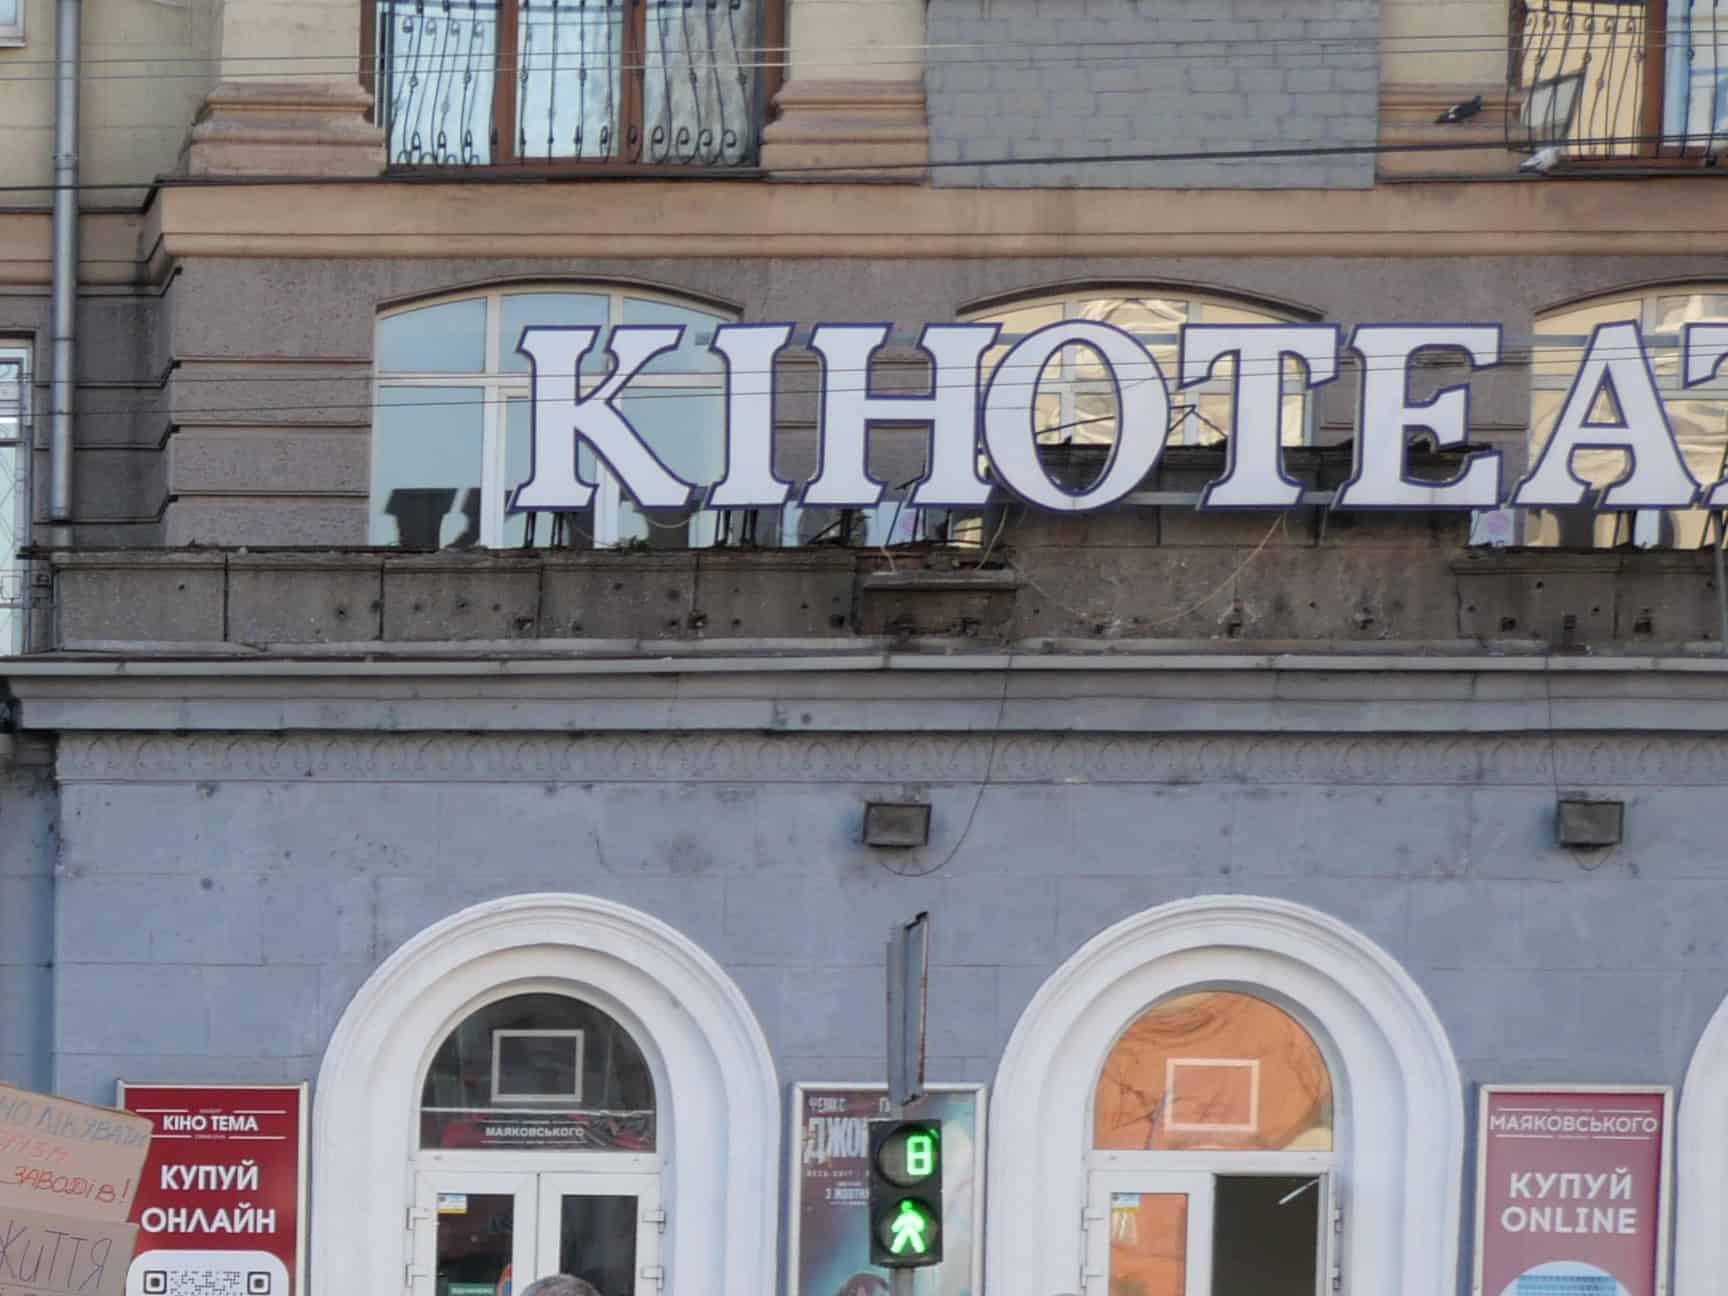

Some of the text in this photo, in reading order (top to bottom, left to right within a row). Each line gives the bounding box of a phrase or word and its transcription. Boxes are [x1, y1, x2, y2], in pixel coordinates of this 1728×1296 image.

[163, 1115, 259, 1132] КІНО ТЕМА
[485, 1127, 585, 1138] МАЯКОВСЬКОГО
[1489, 1115, 1659, 1132] МАЯКОВСЬКОГО
[160, 1160, 260, 1191] КУПУЙ
[1509, 1168, 1632, 1200] КУПУЙ
[141, 1203, 277, 1233] ОНЛАЙН
[1501, 1206, 1638, 1234] ONLINE
